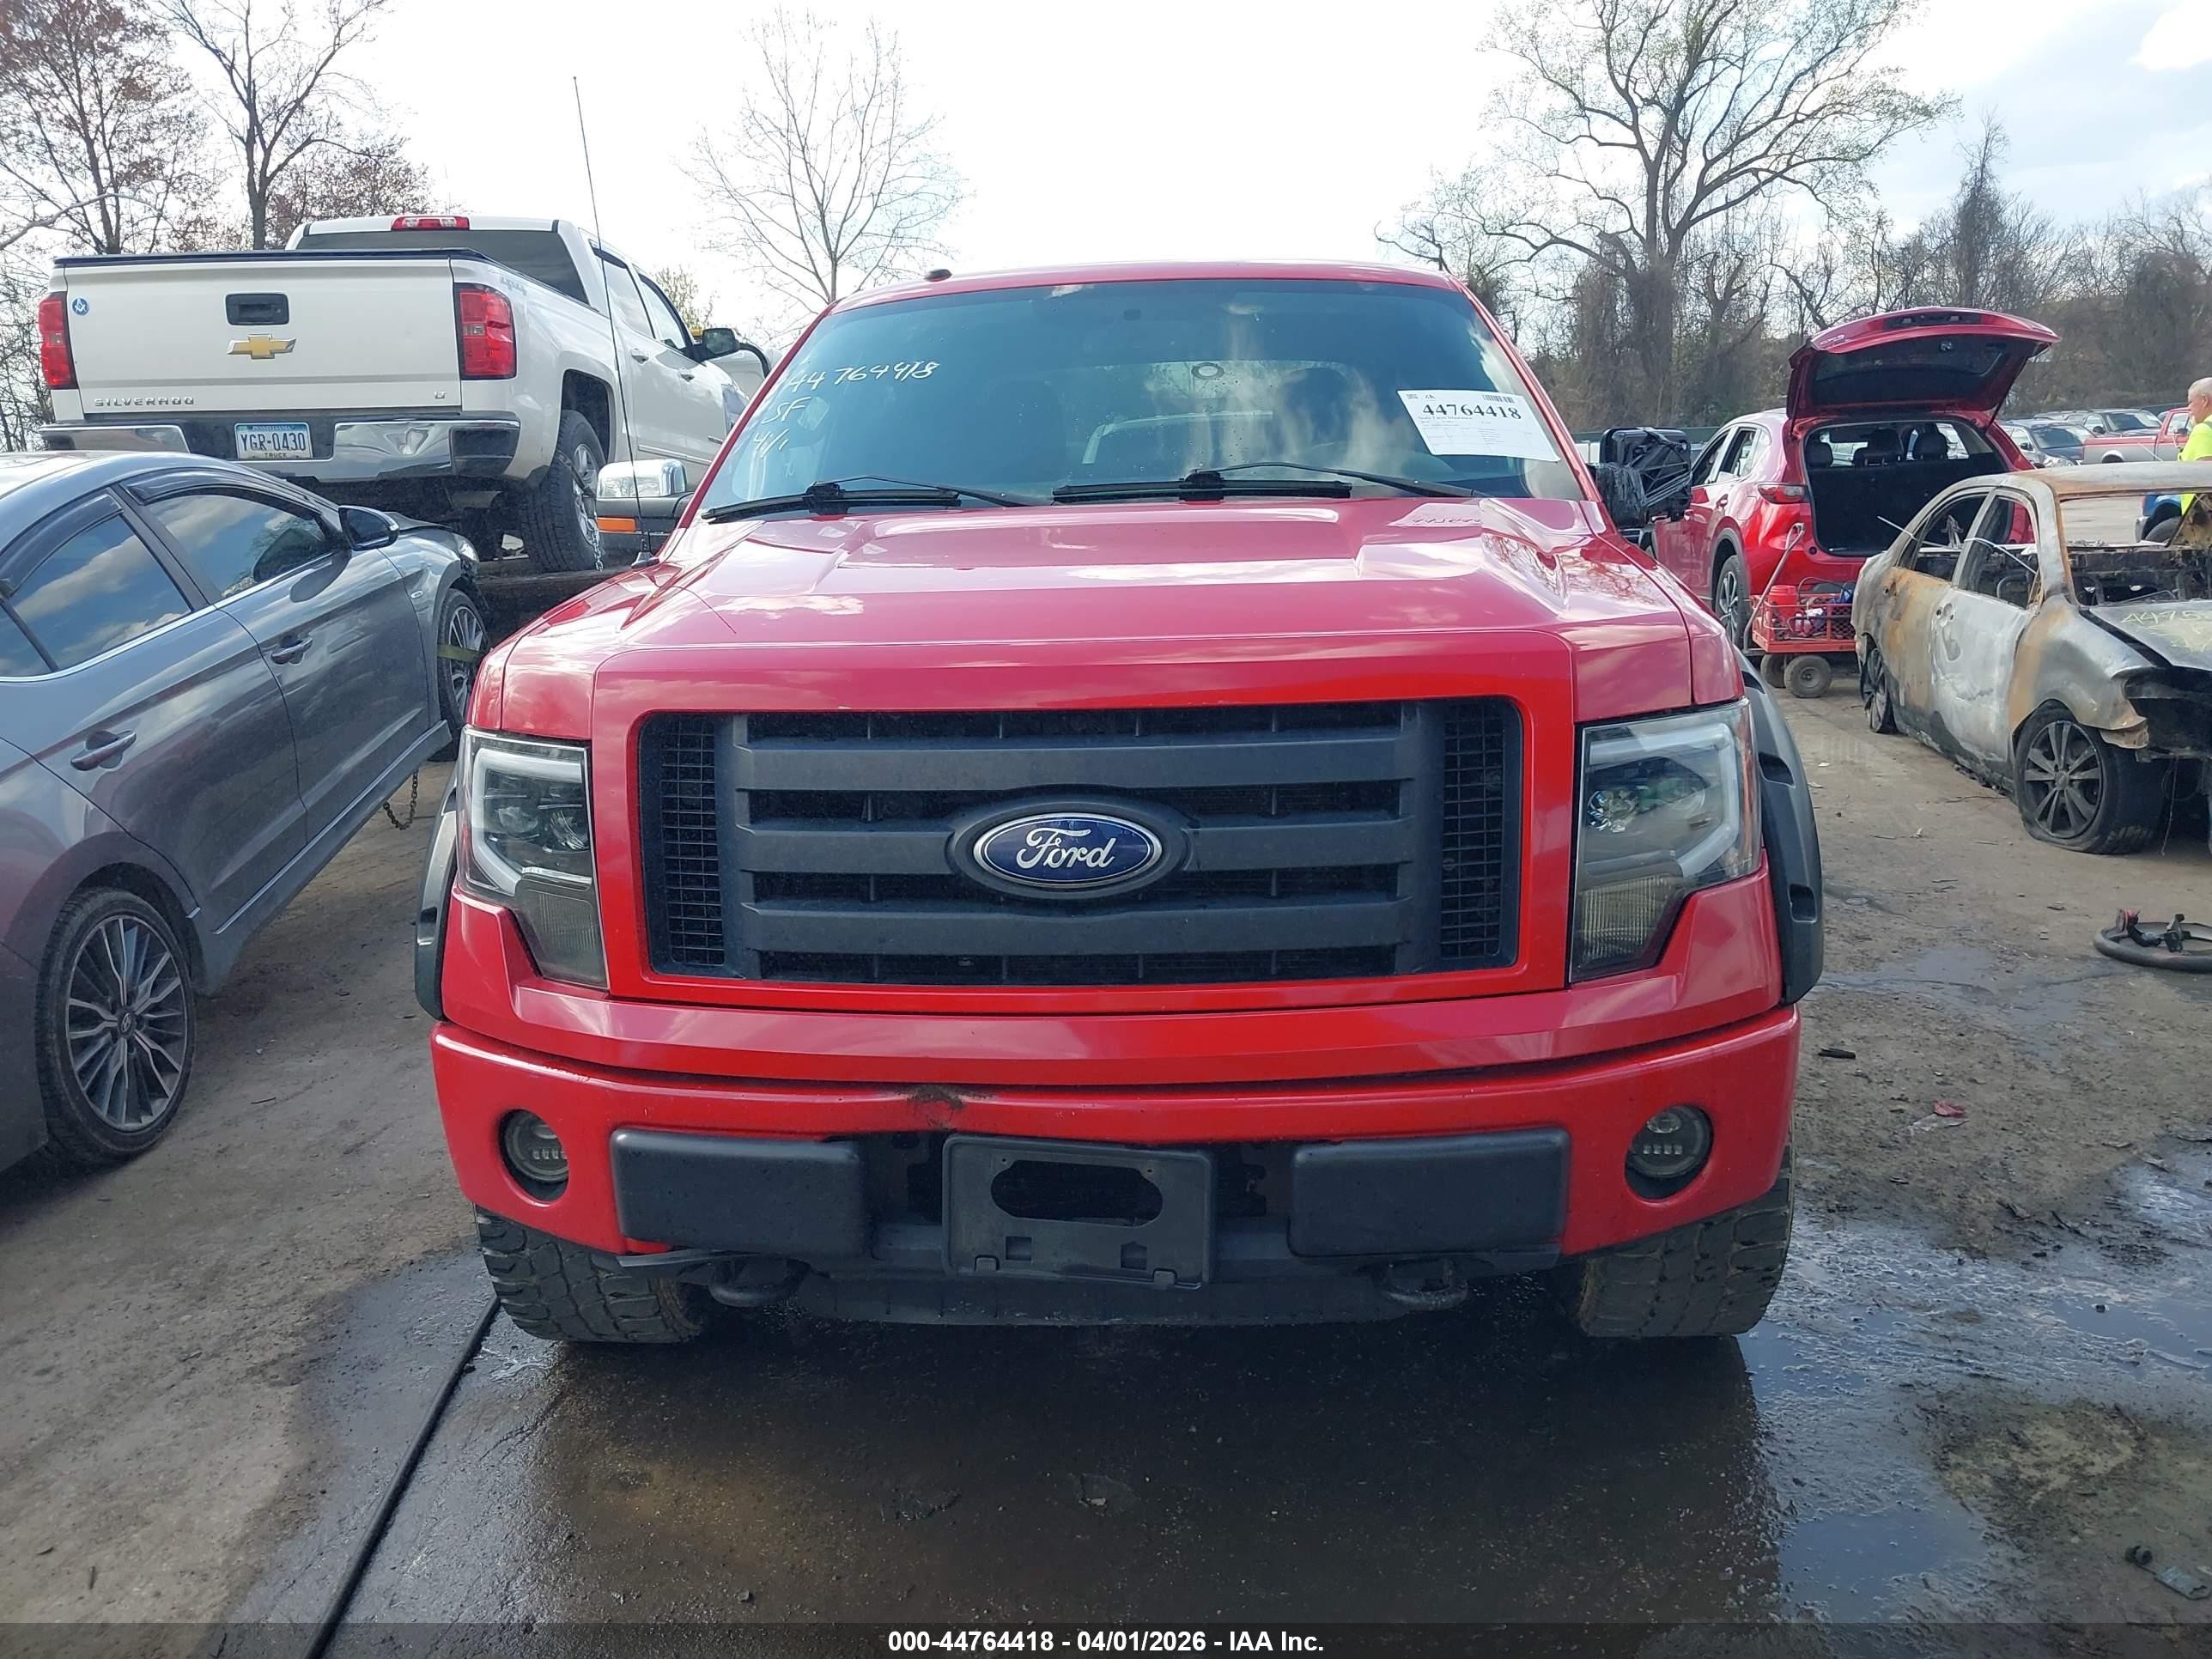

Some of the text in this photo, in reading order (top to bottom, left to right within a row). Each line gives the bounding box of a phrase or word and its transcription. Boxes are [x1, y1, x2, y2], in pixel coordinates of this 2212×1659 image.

[434, 391, 447, 399] LT
[94, 397, 194, 407] SILVERADO
[1423, 404, 1522, 420] 44764418
[1016, 827, 1116, 869] Ford
